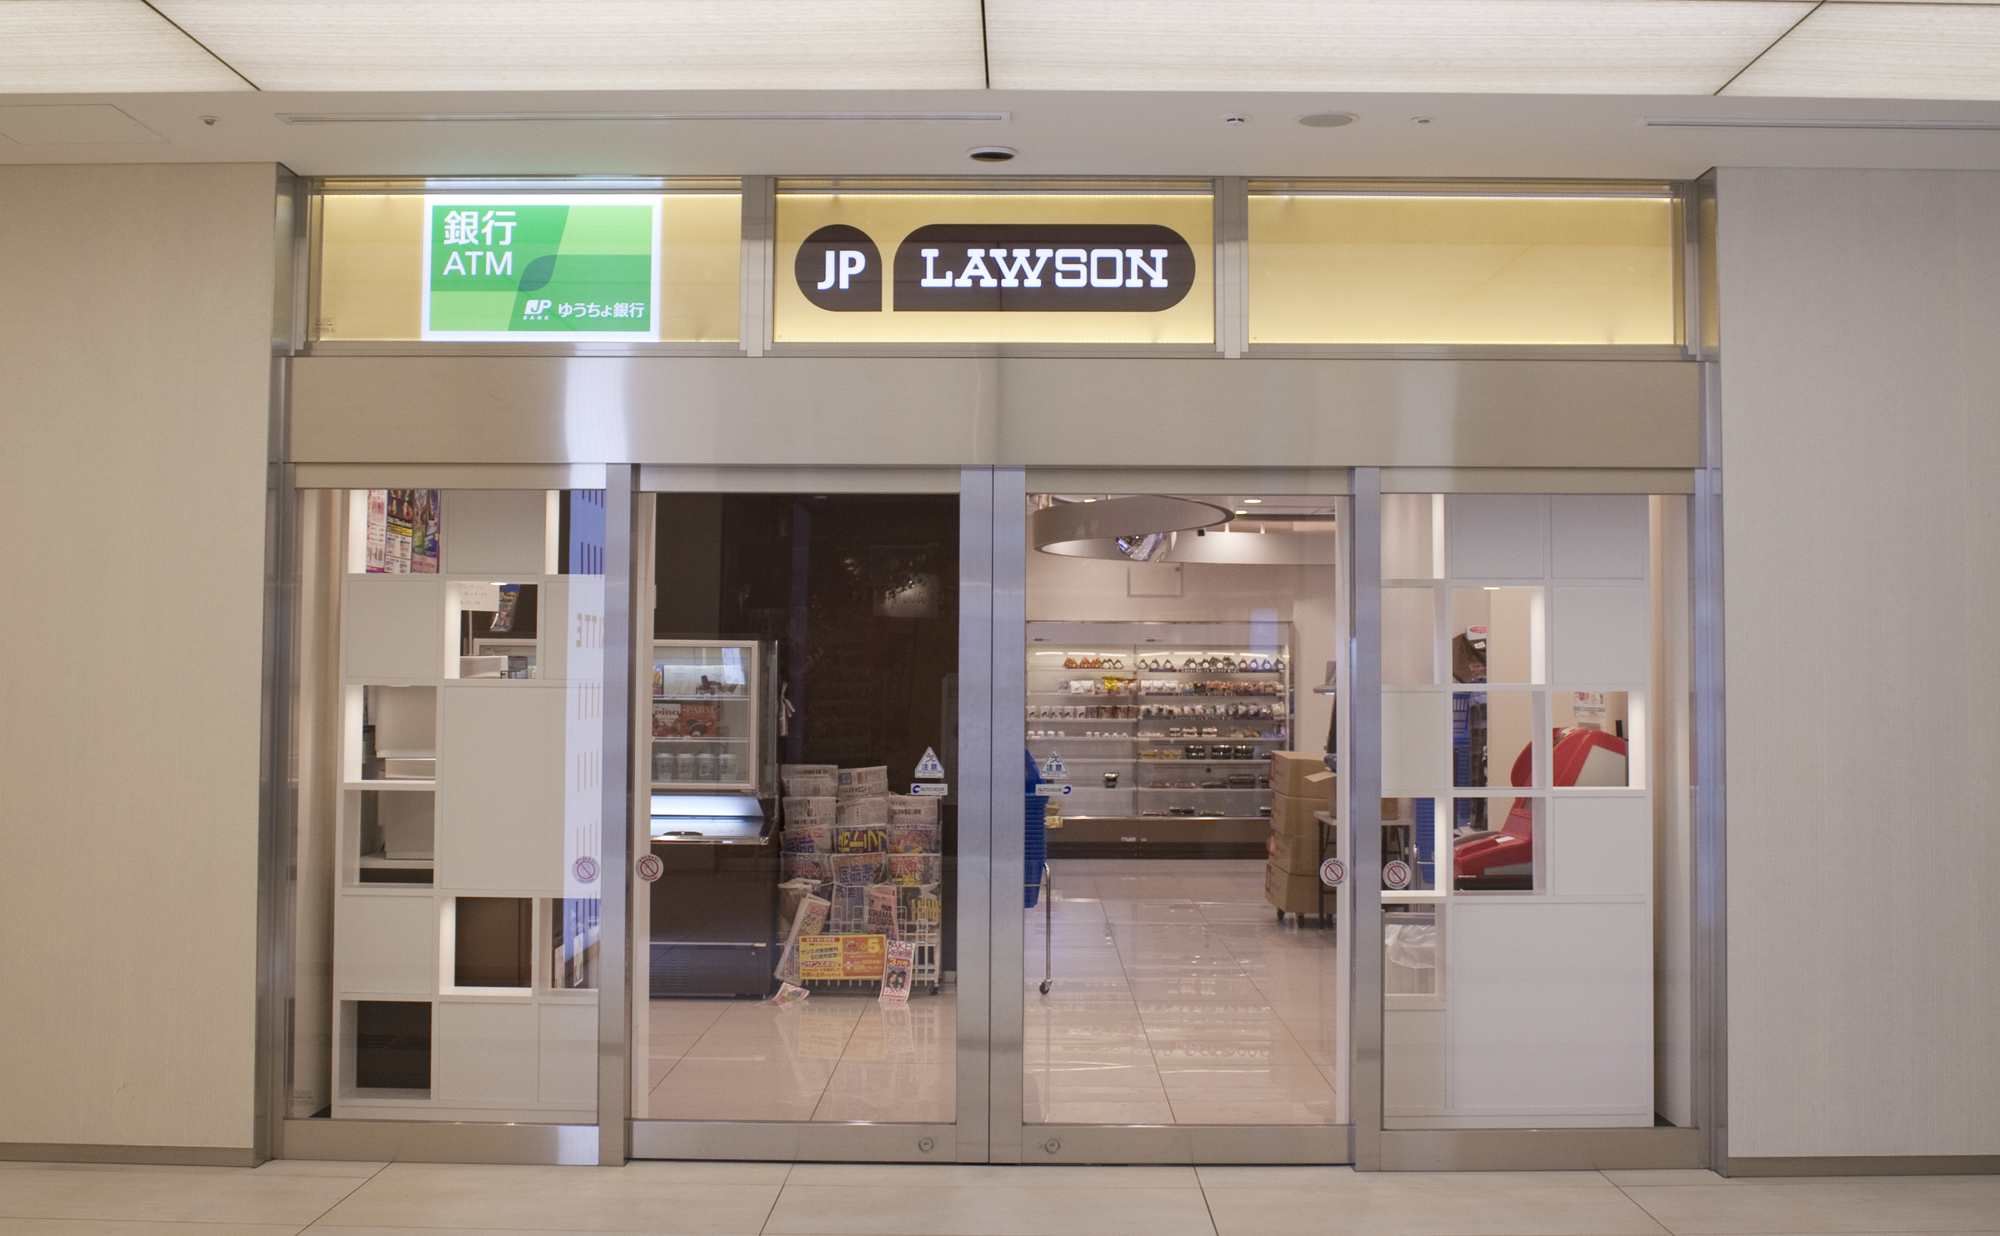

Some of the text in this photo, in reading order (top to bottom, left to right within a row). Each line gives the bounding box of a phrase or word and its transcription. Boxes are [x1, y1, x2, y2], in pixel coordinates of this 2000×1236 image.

[443, 209, 517, 246] 銀行
[442, 251, 513, 276] ATM
[817, 248, 1169, 290] JP LAWSON
[524, 299, 552, 315] JP
[558, 302, 645, 318] ゆうちょ銀行
[654, 707, 680, 716] pino
[686, 706, 714, 714] PARM
